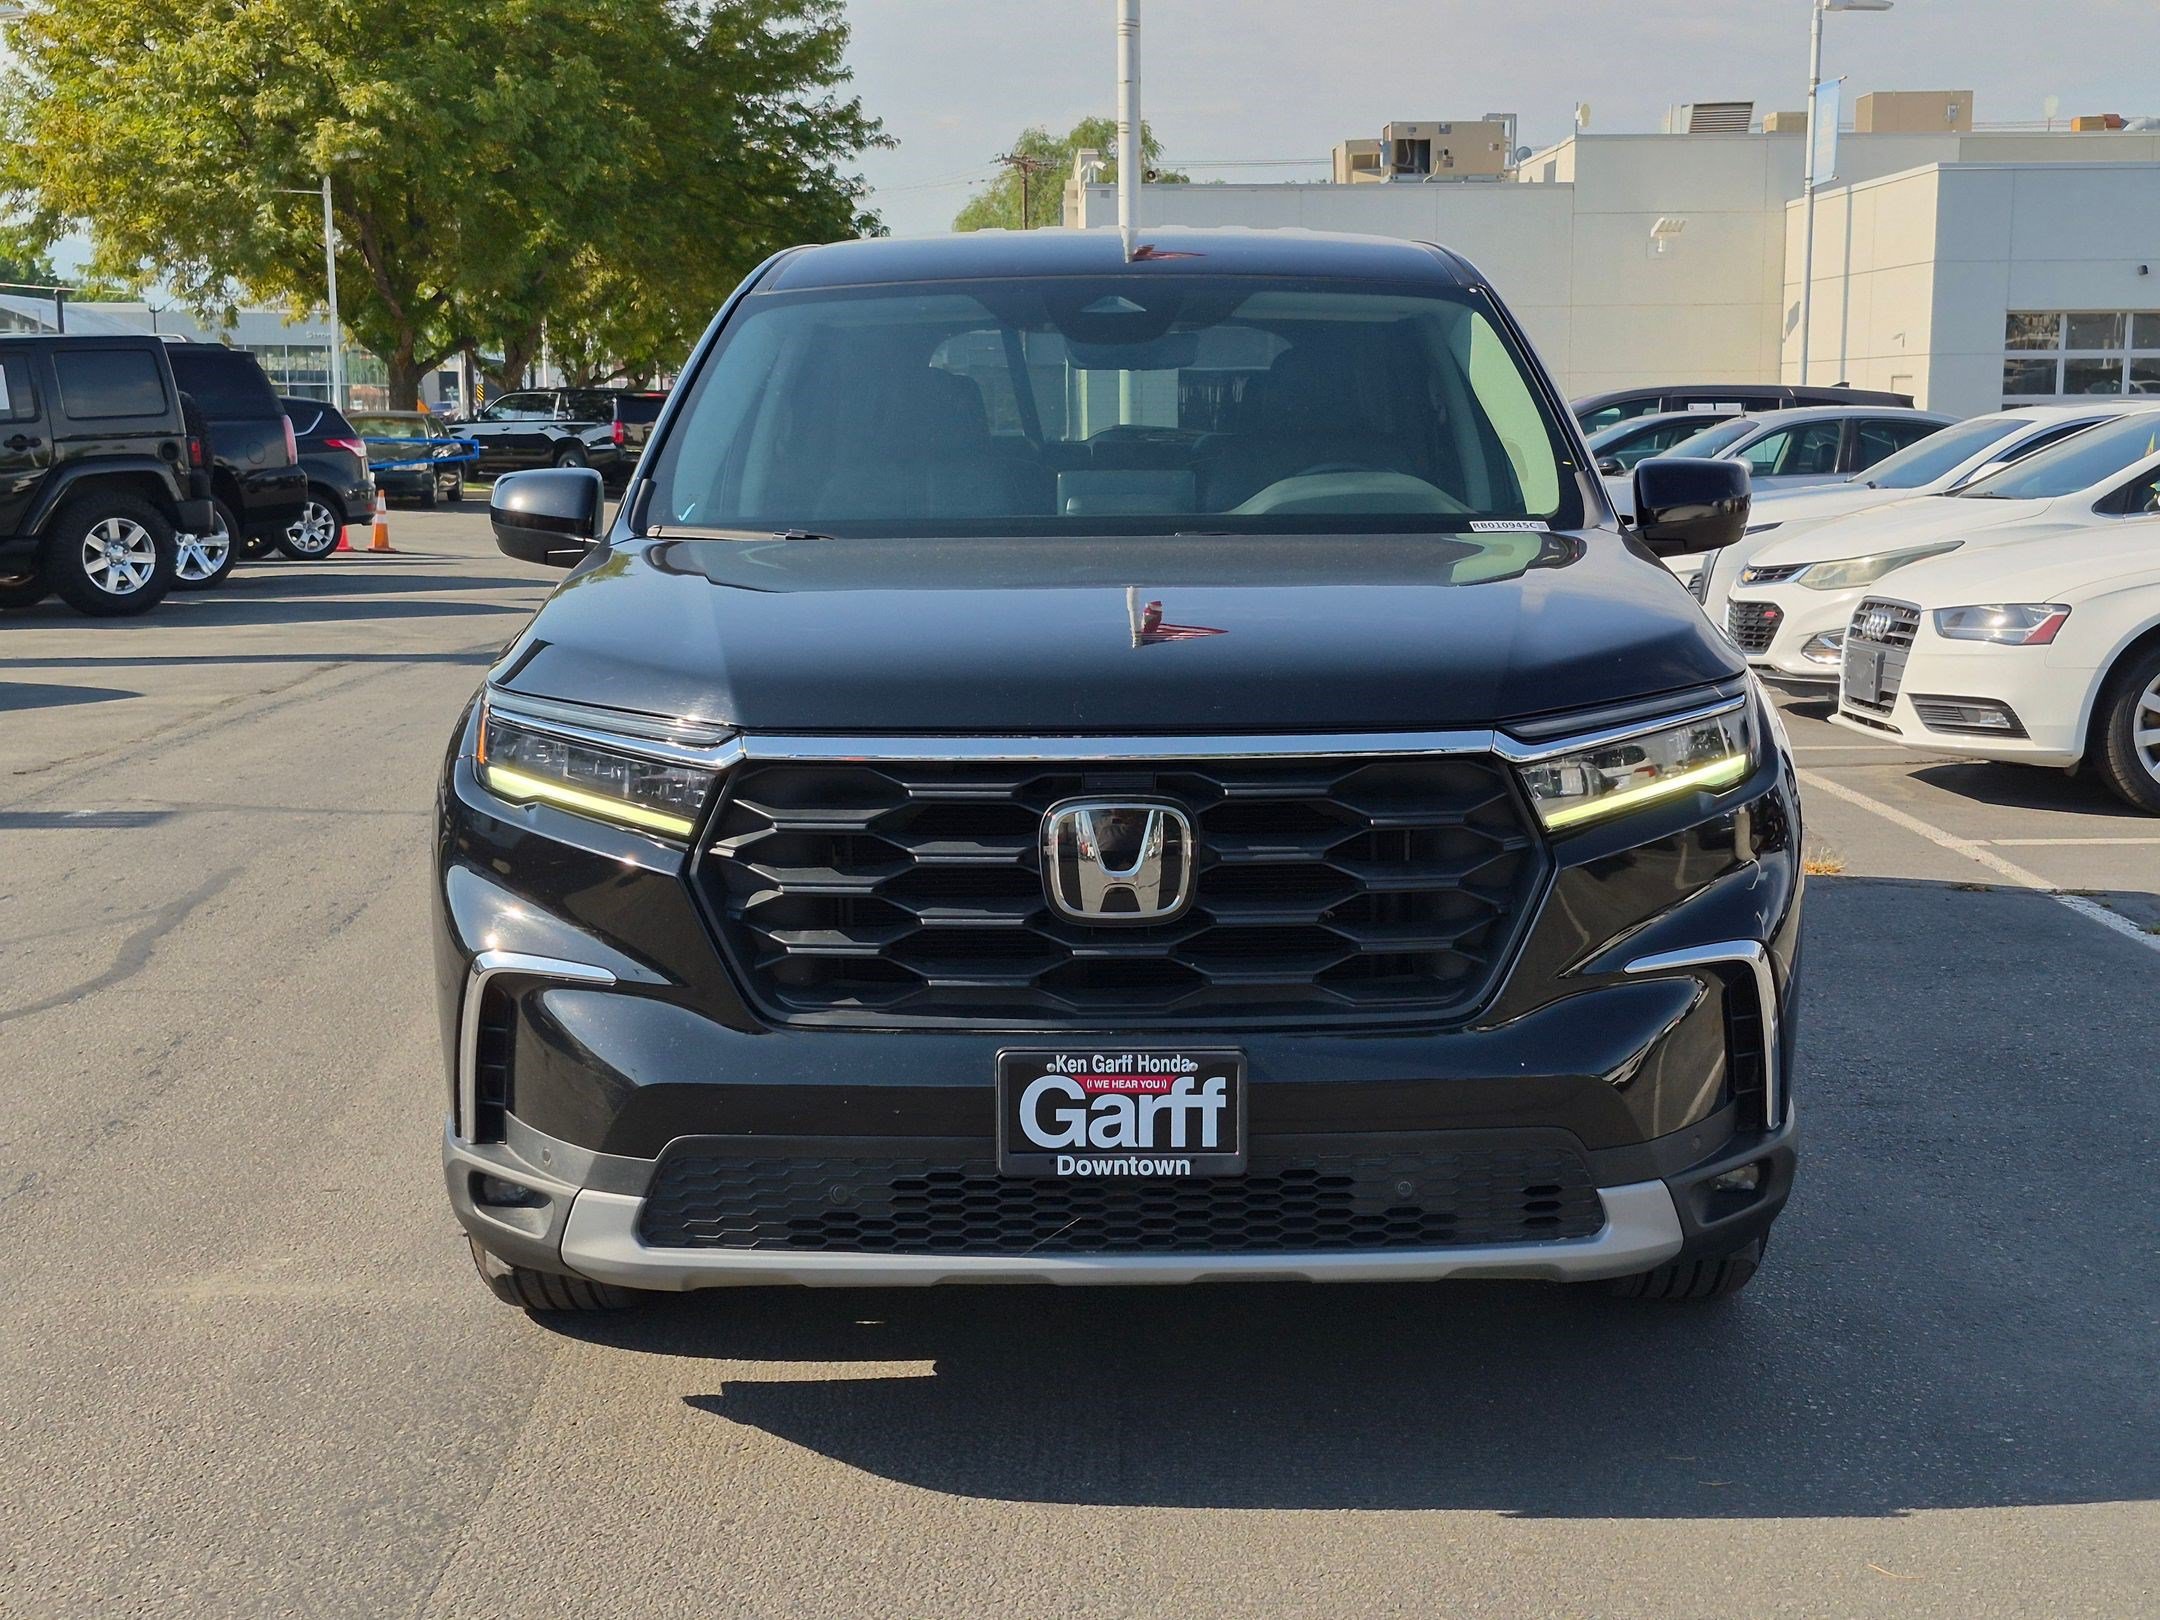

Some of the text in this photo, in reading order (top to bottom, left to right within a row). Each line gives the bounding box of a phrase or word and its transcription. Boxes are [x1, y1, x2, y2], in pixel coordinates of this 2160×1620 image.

[1055, 1054, 1191, 1073] Ken Garff Honda
[1094, 1080, 1160, 1089] WE HEAR YOU
[1019, 1075, 1227, 1149] Garff
[1057, 1155, 1191, 1176] Downtown
